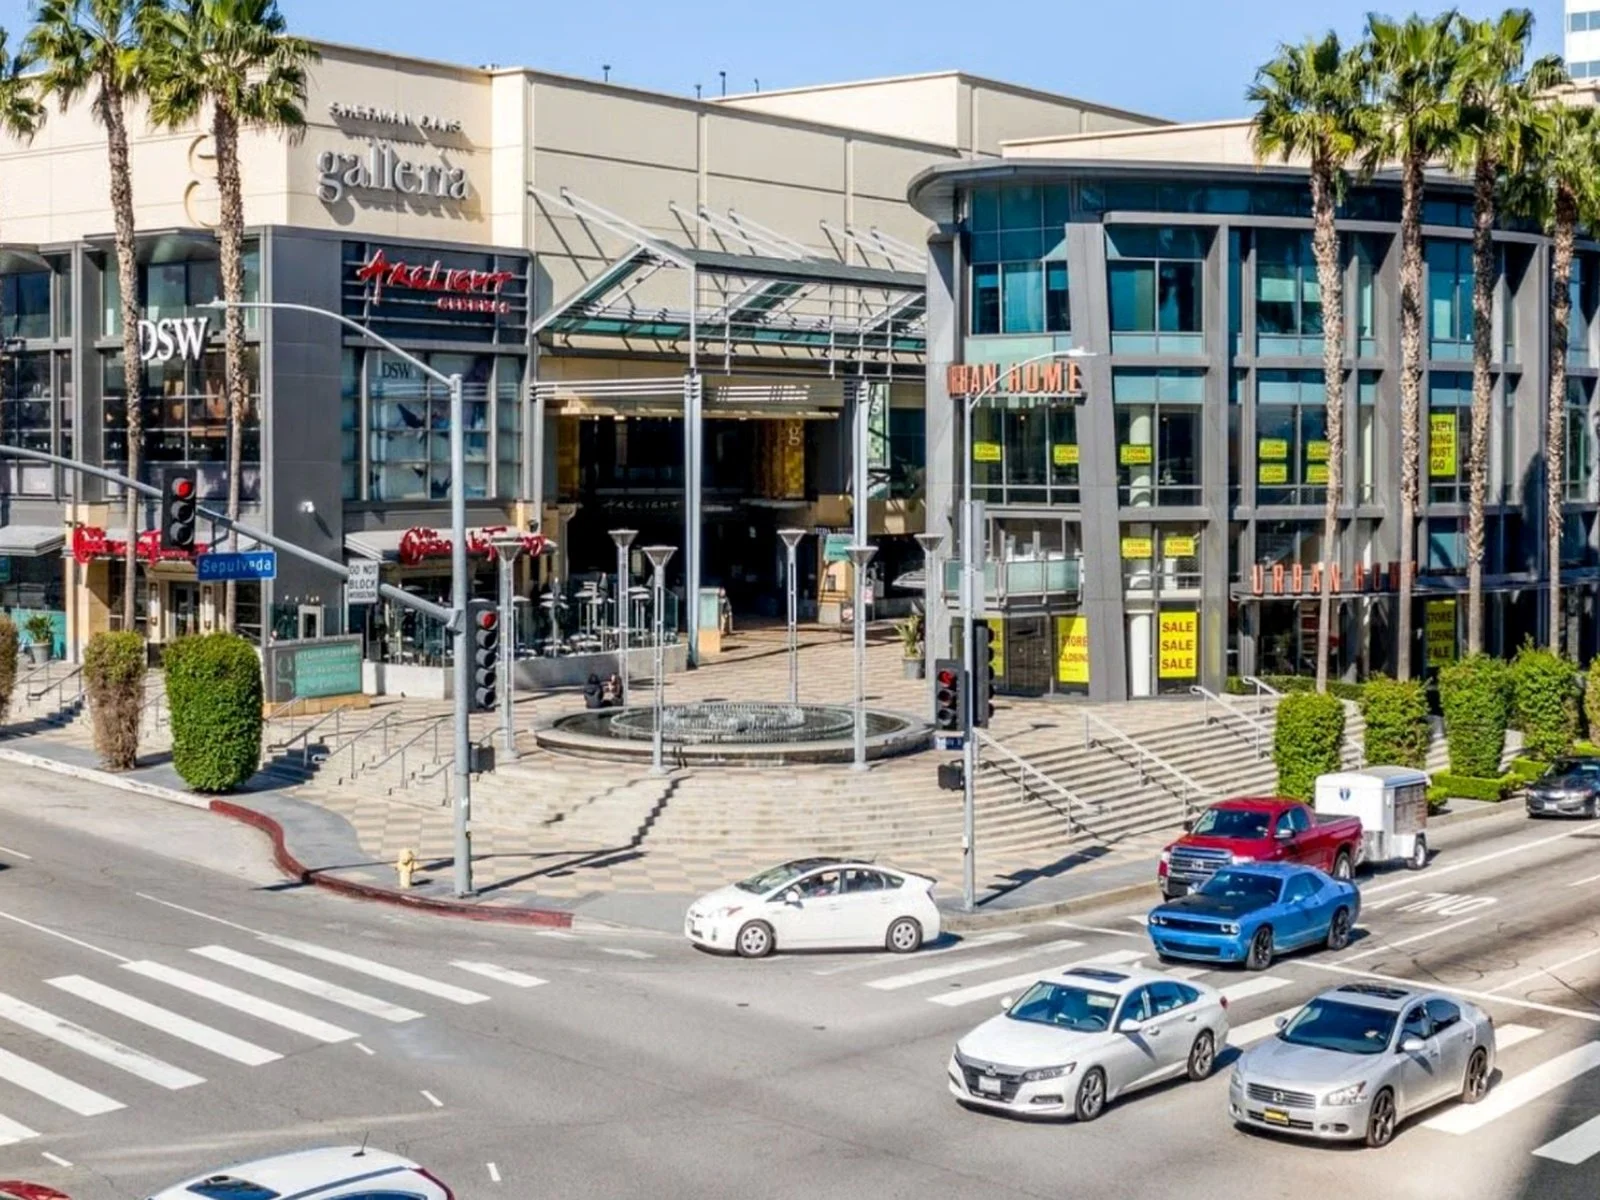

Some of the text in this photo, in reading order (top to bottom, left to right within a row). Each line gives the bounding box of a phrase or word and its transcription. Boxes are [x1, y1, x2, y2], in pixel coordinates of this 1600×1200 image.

[316, 142, 470, 202] galleria
[137, 316, 208, 360] DSW
[381, 361, 410, 379] DSW
[1008, 360, 1082, 394] HOME
[202, 558, 272, 575] Sepulveda
[349, 563, 377, 575] DO NOT
[349, 579, 376, 589] BLOCK
[1253, 562, 1341, 595] URBAN
[1162, 621, 1193, 633] SALE
[1162, 639, 1193, 651] SALE
[1162, 658, 1193, 670] SALE
